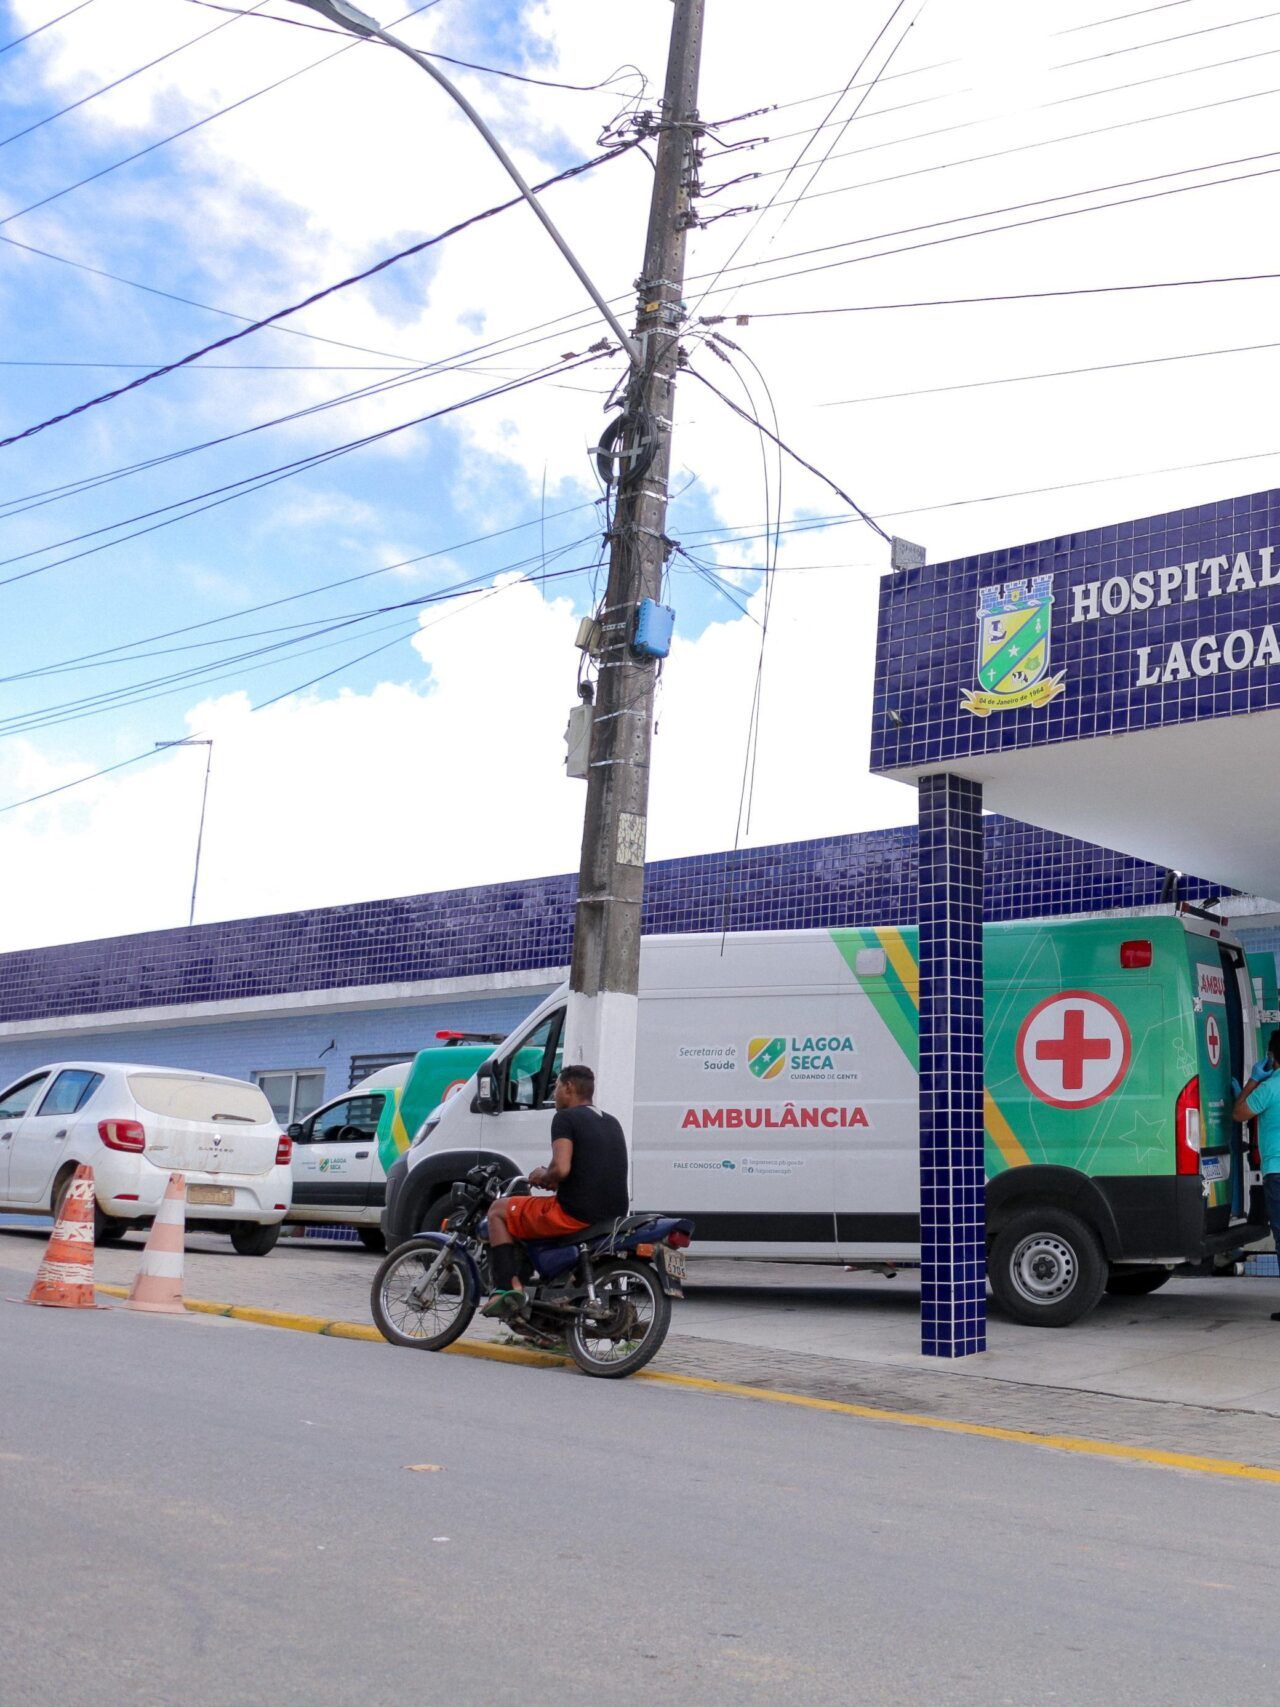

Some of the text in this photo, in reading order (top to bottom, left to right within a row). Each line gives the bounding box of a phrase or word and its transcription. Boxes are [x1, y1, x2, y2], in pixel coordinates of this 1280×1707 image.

[996, 698, 1019, 706] Janeiro
[1029, 686, 1045, 698] 1964
[791, 1037, 854, 1051] LAGOA
[679, 1047, 736, 1057] Secretaria de
[704, 1060, 735, 1070] Saúde
[790, 1055, 834, 1070] SECA
[681, 1102, 869, 1128] AMBULÂNCIA
